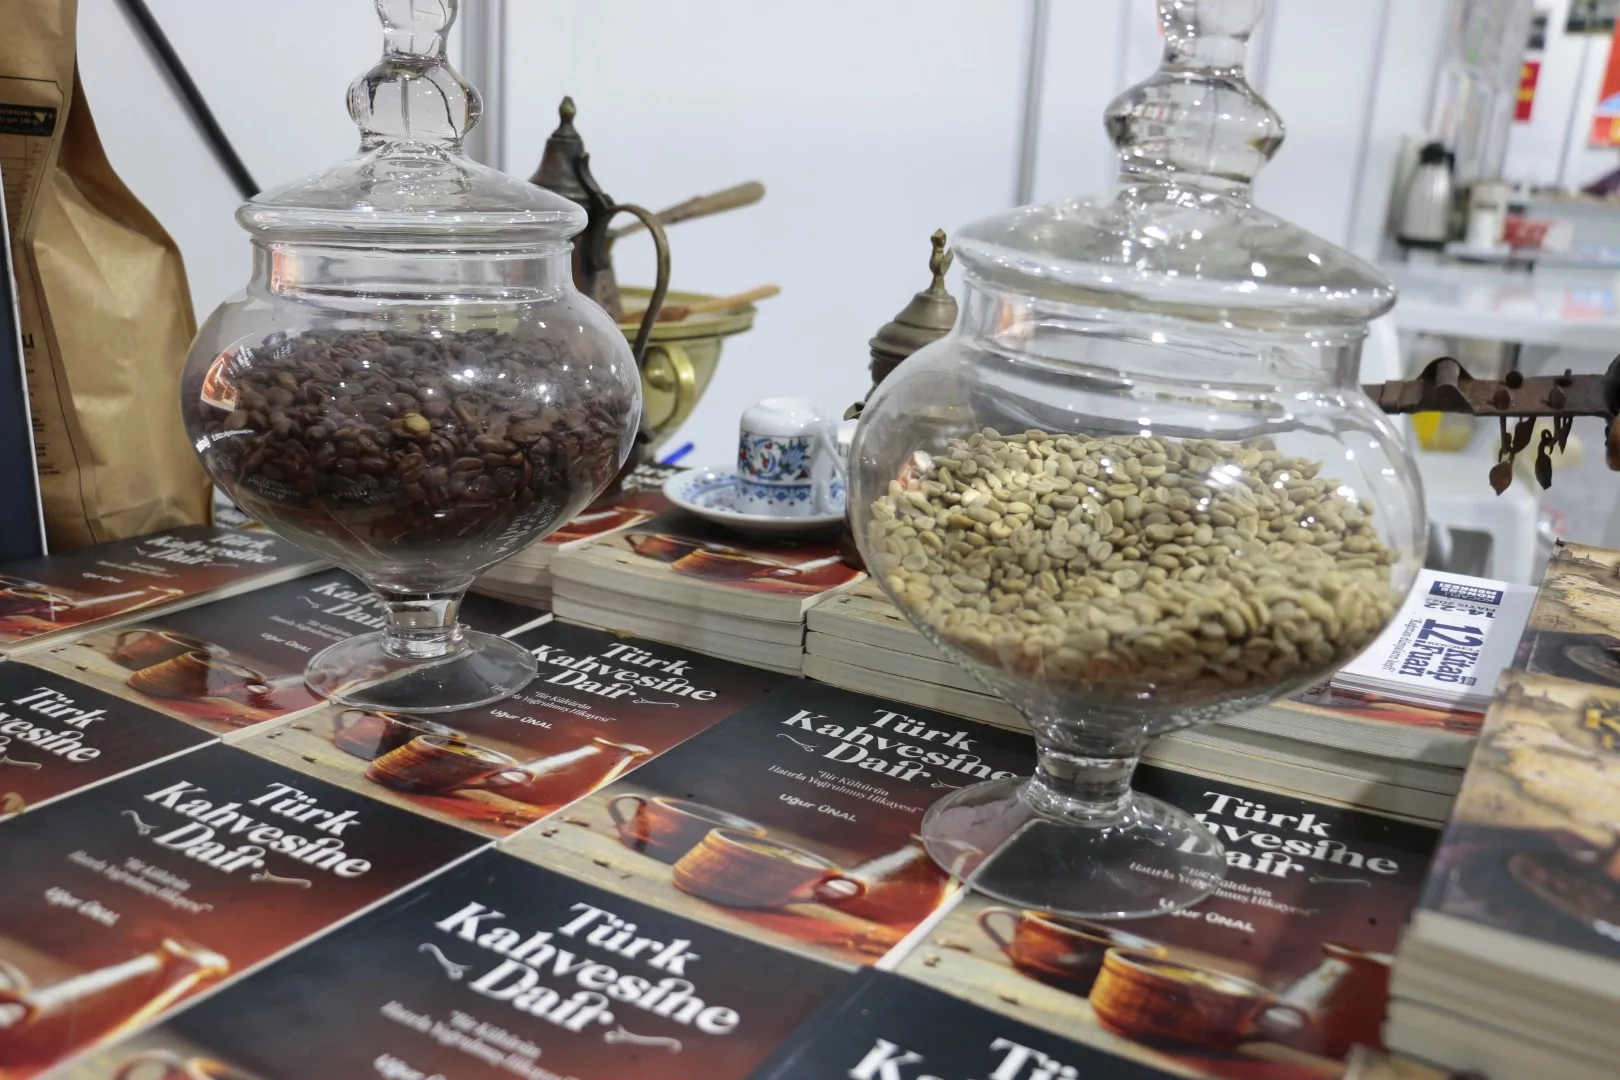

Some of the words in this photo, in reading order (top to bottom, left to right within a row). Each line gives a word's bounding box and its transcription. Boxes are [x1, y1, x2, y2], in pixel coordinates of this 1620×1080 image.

[530, 644, 717, 701] Kahvesine
[544, 668, 638, 699] Dair
[601, 642, 693, 677] Türk
[1426, 647, 1479, 683] Kitap
[12, 686, 108, 729] Türk
[869, 709, 978, 752] Türk
[781, 709, 1019, 781] Kahvesine
[822, 742, 931, 783] Dair
[143, 780, 372, 878] Kahvesine
[249, 781, 362, 837] Türk
[779, 793, 816, 809] Uğur
[817, 803, 857, 823] ÜNAL
[1203, 791, 1331, 838] Türk
[152, 821, 267, 873] Dair
[557, 901, 700, 976] Türk
[435, 900, 740, 1035] Kahvesine
[468, 957, 615, 1033] Dair
